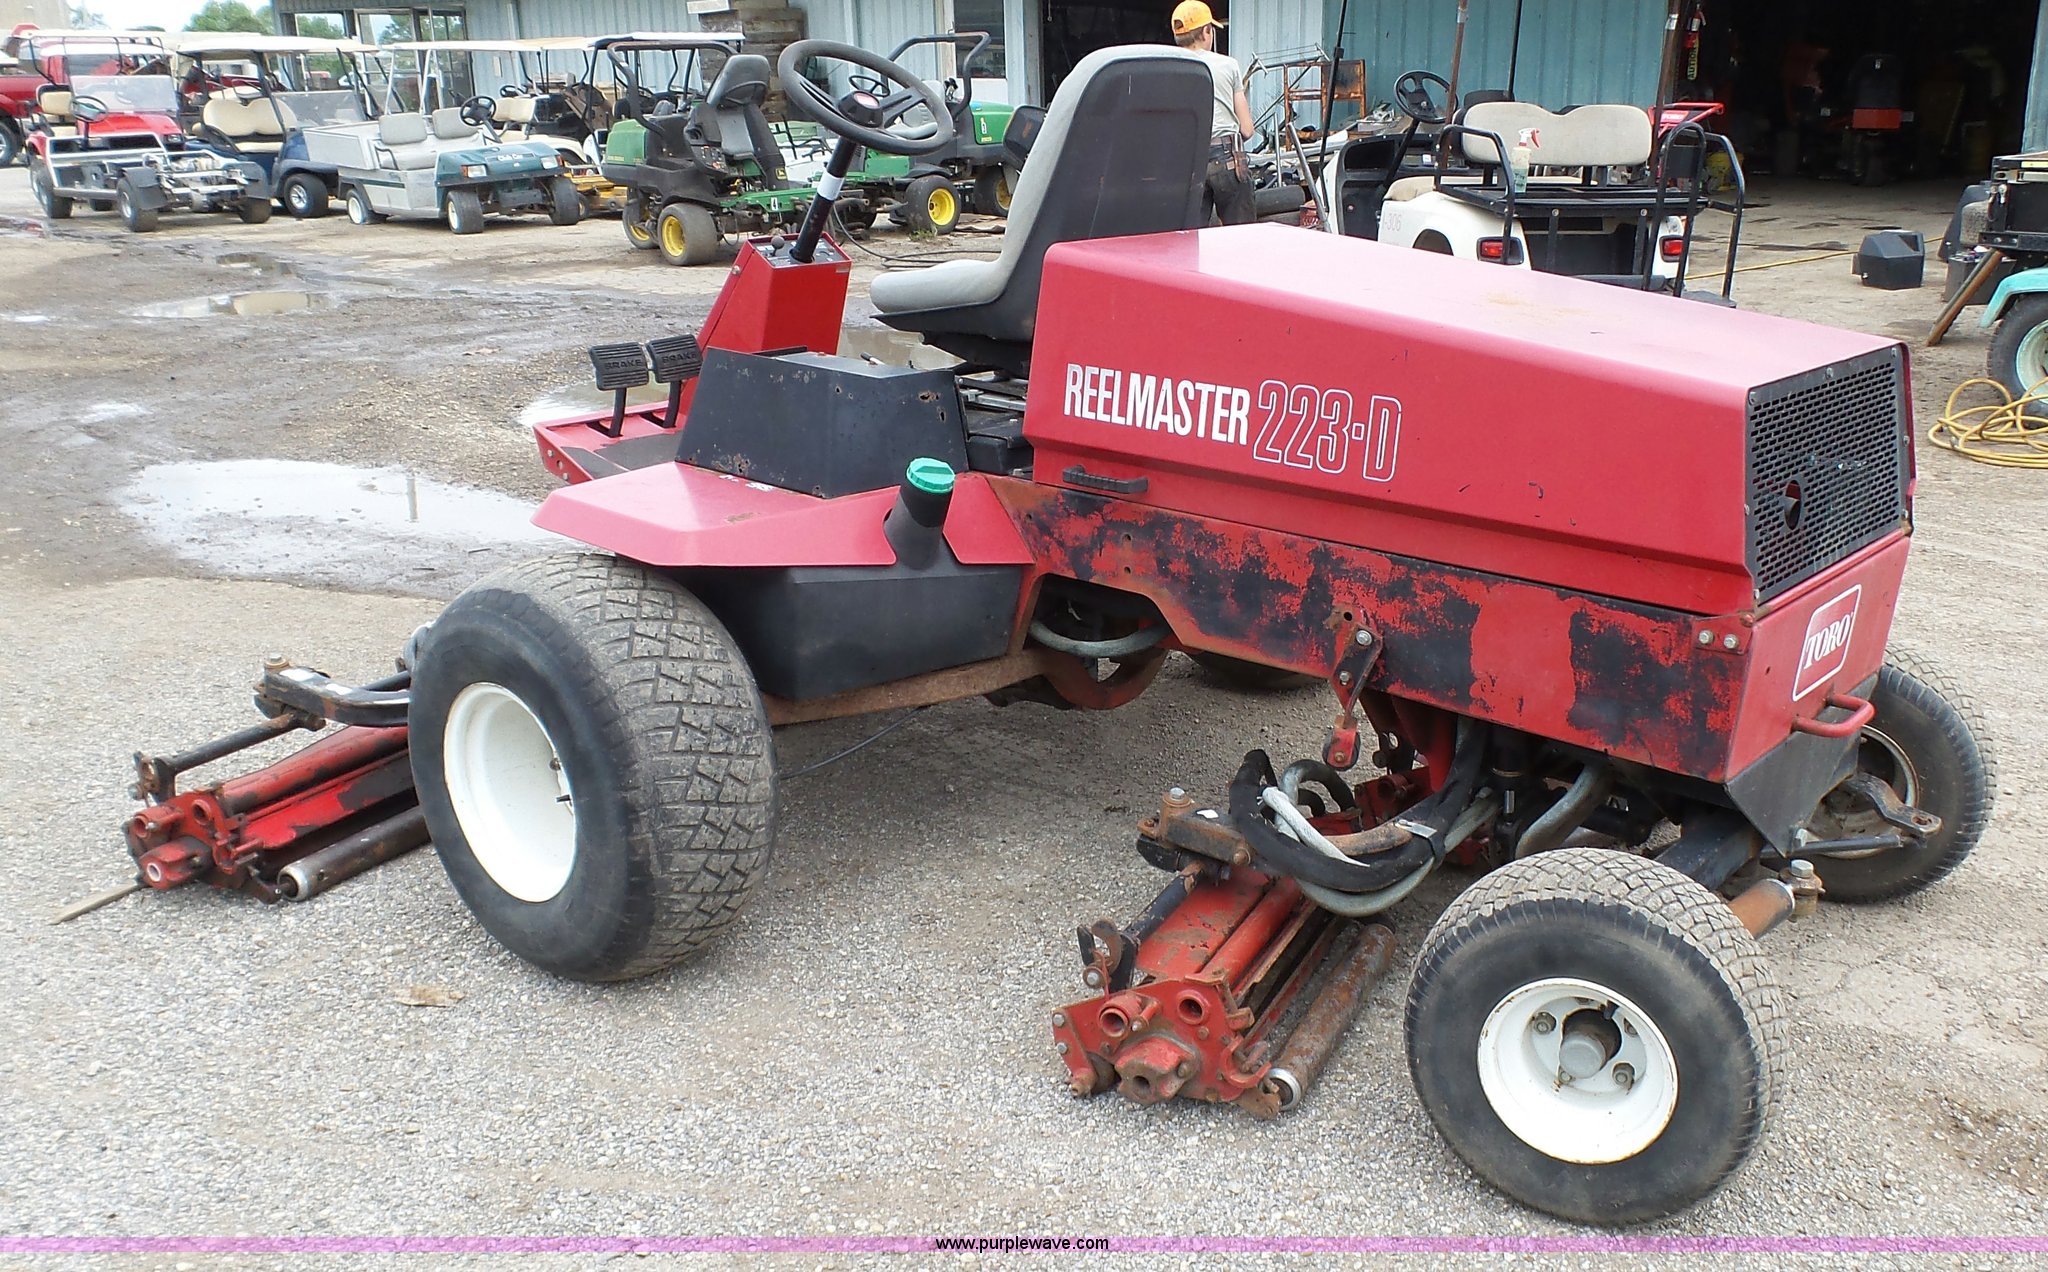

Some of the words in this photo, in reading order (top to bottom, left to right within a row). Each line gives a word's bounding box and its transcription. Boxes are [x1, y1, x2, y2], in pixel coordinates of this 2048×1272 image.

[604, 358, 643, 370] BRAKE
[661, 351, 698, 364] BRAKE
[1063, 363, 1250, 446] REELMASTER
[1803, 613, 1851, 670] TORO
